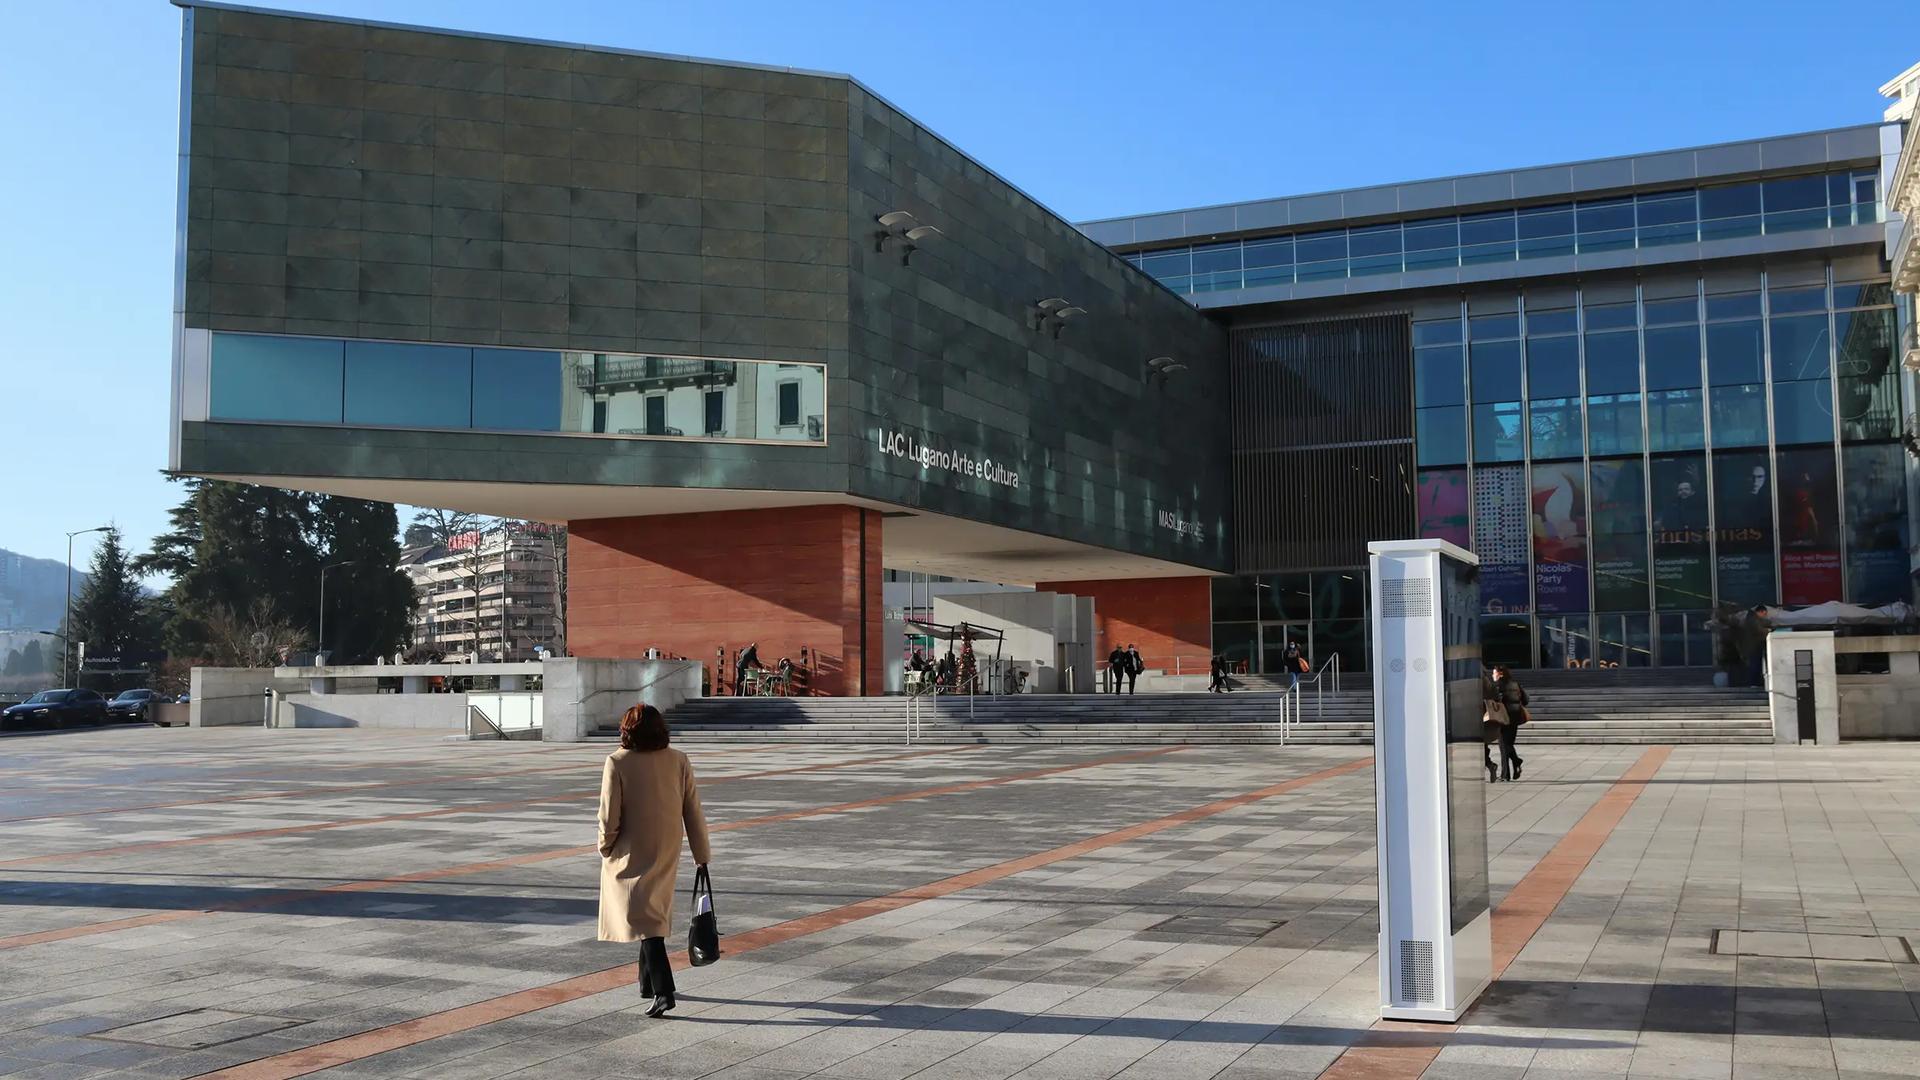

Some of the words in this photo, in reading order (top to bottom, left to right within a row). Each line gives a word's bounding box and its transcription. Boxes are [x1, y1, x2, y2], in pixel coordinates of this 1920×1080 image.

[878, 427, 905, 458] LAC
[908, 436, 950, 470] Lugano
[951, 449, 974, 477] Arte
[975, 462, 983, 479] e
[983, 458, 1019, 489] Cultura
[1536, 564, 1573, 573] Nicolas
[1536, 574, 1562, 584] Party
